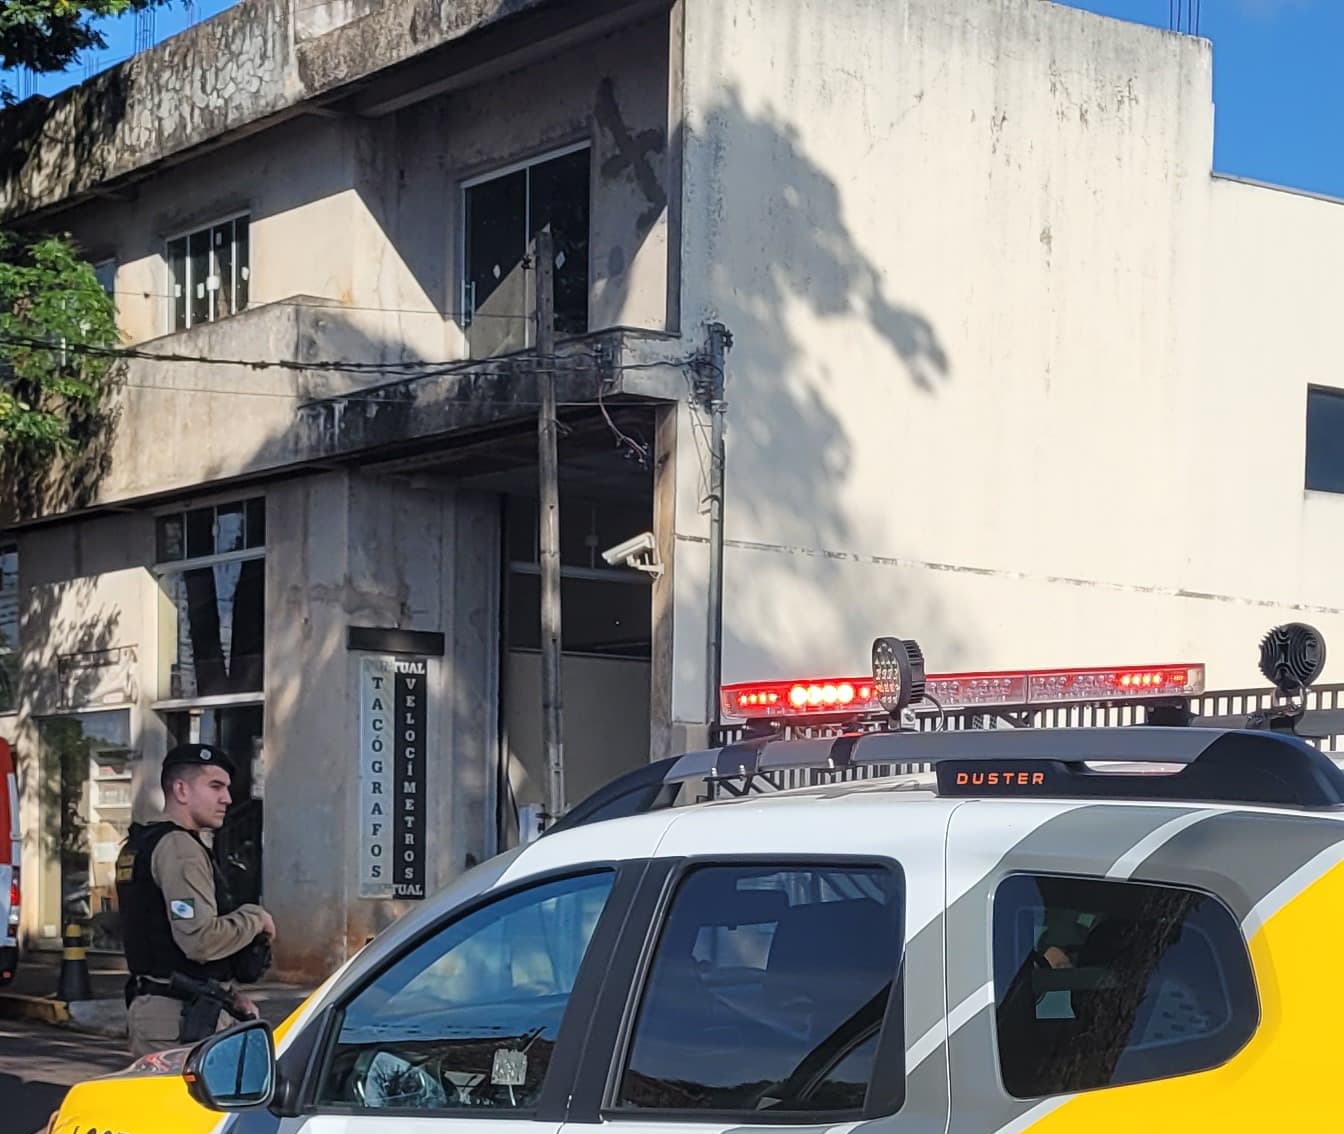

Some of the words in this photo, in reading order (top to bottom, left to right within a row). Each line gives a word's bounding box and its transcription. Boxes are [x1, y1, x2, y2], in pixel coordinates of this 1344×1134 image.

[370, 676, 384, 878] TACÓGRAFOS
[403, 678, 417, 879] VELOCÍMETROS
[956, 772, 1045, 785] DUSTER
